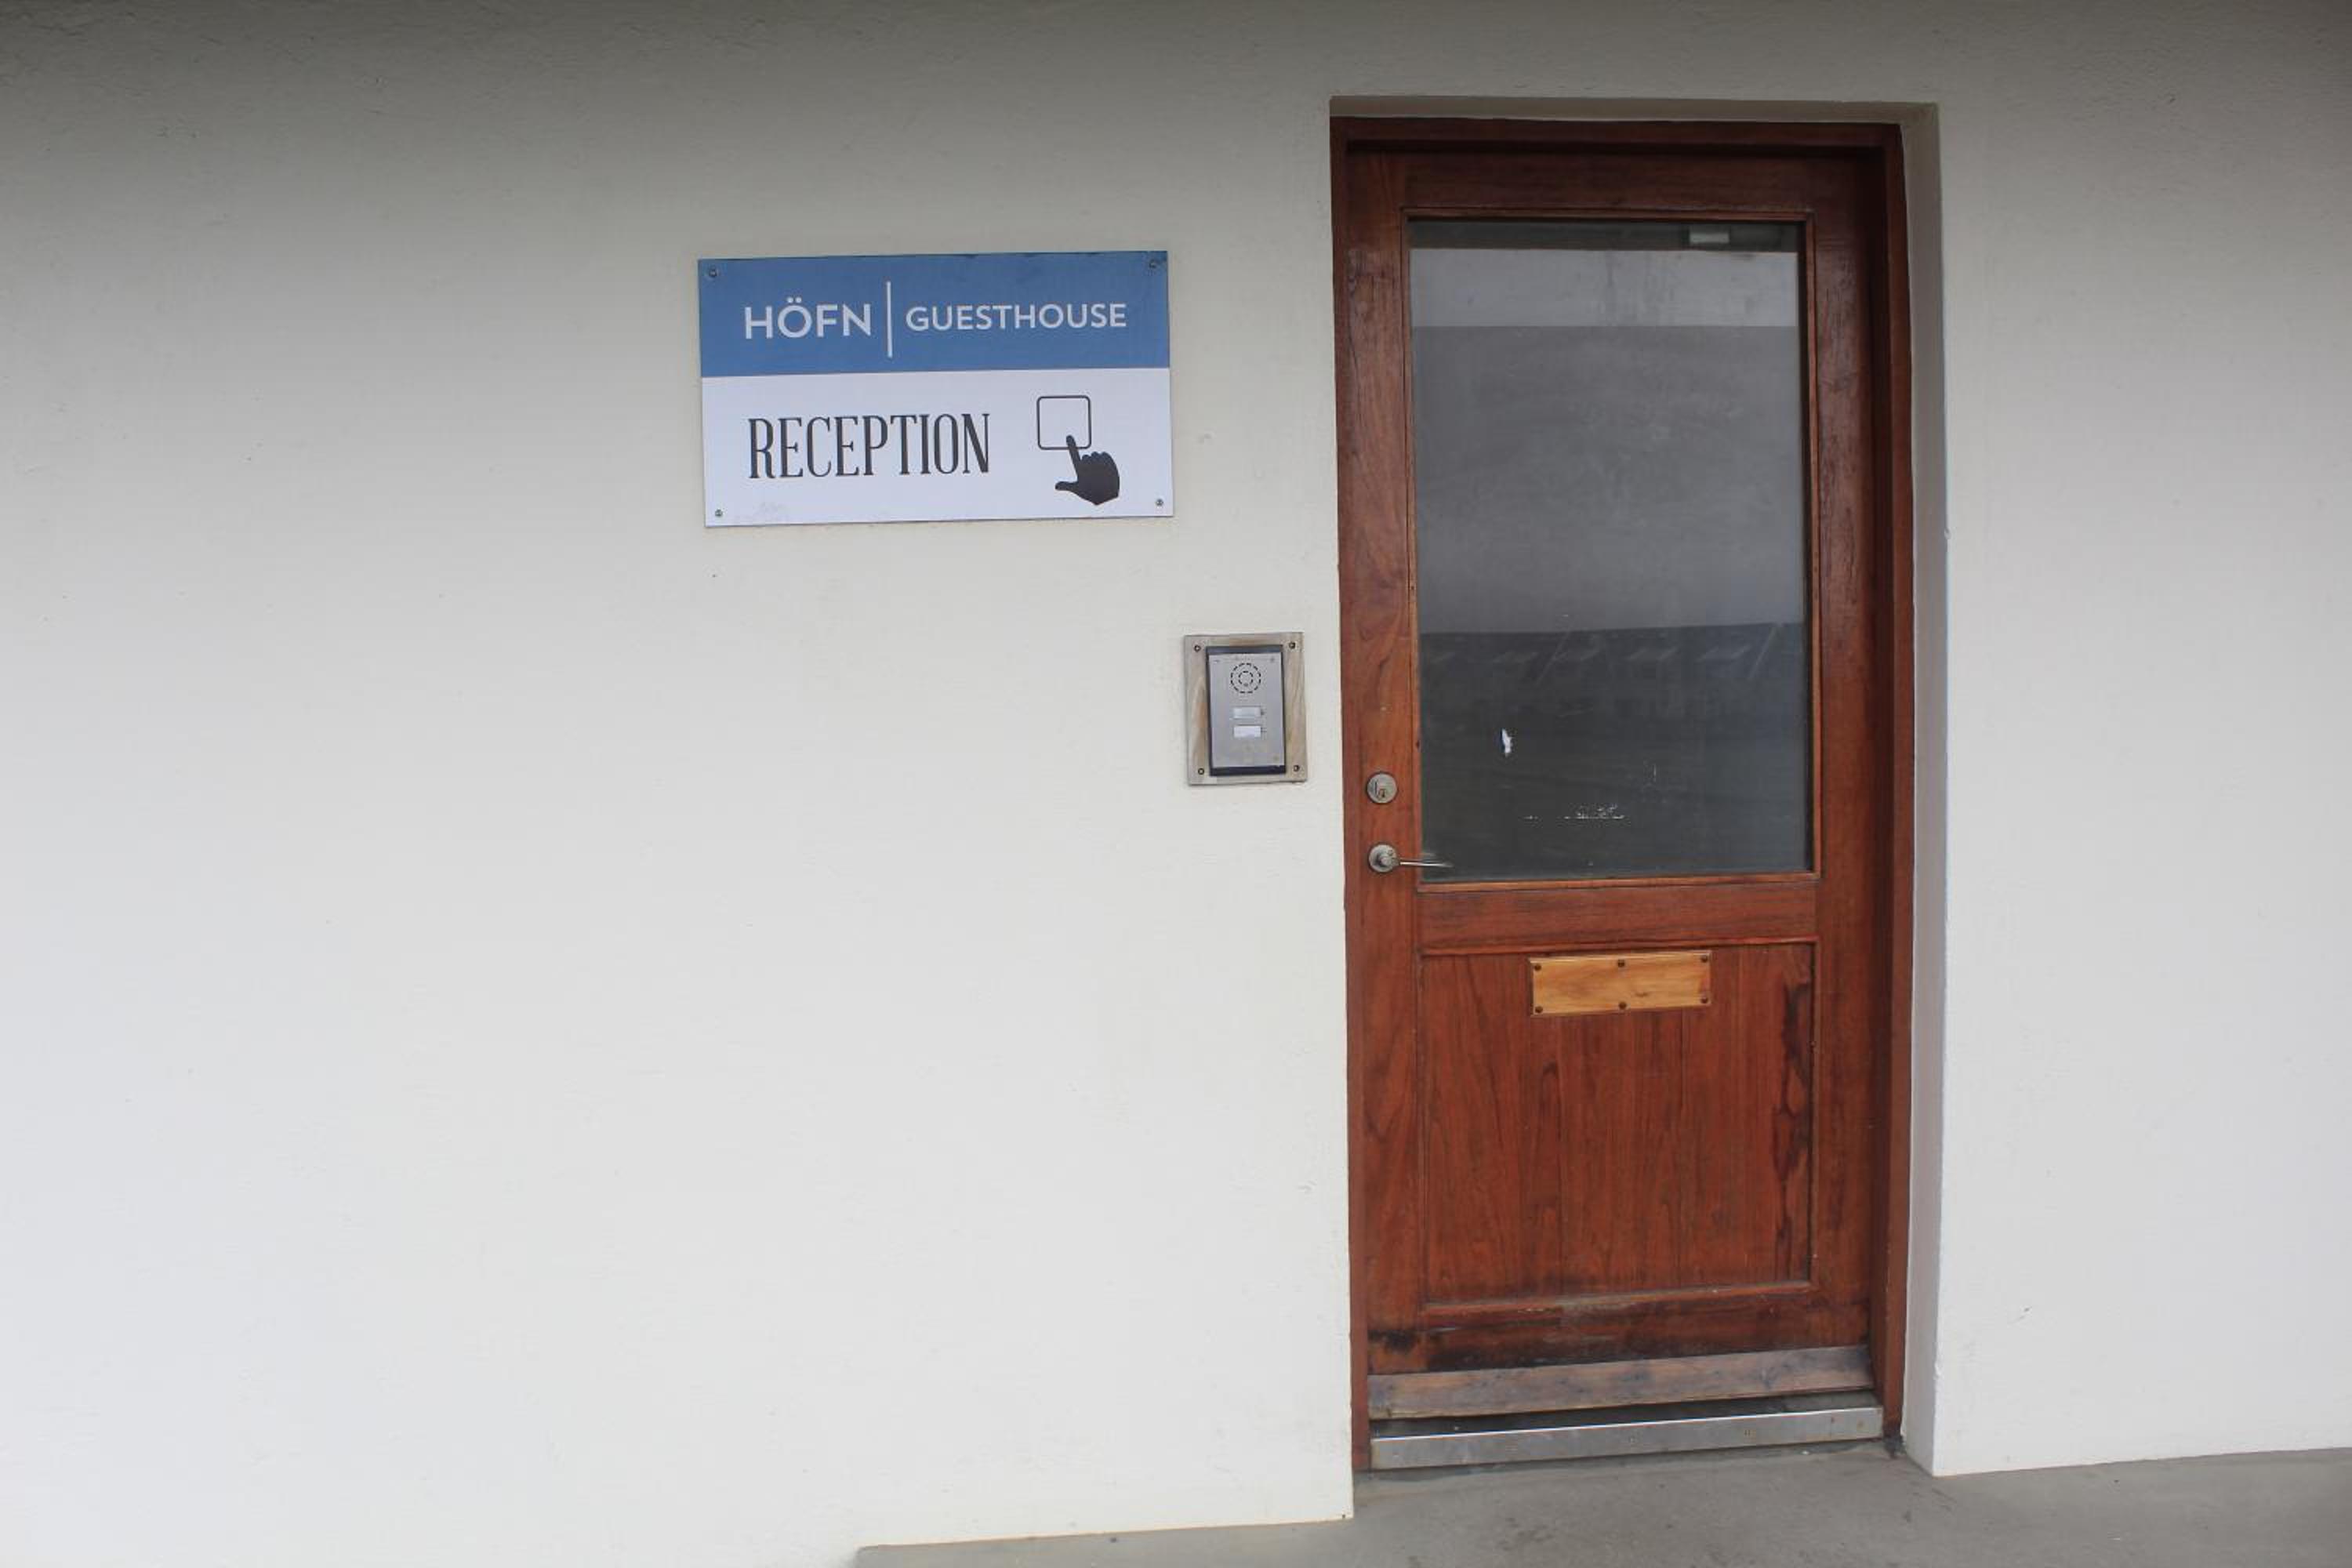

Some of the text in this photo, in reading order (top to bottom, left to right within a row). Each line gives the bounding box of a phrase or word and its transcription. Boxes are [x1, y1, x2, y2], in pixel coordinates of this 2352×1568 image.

[744, 297, 1127, 339] HÖFN GUESTHOUSE
[748, 413, 990, 479] RECEPTION
